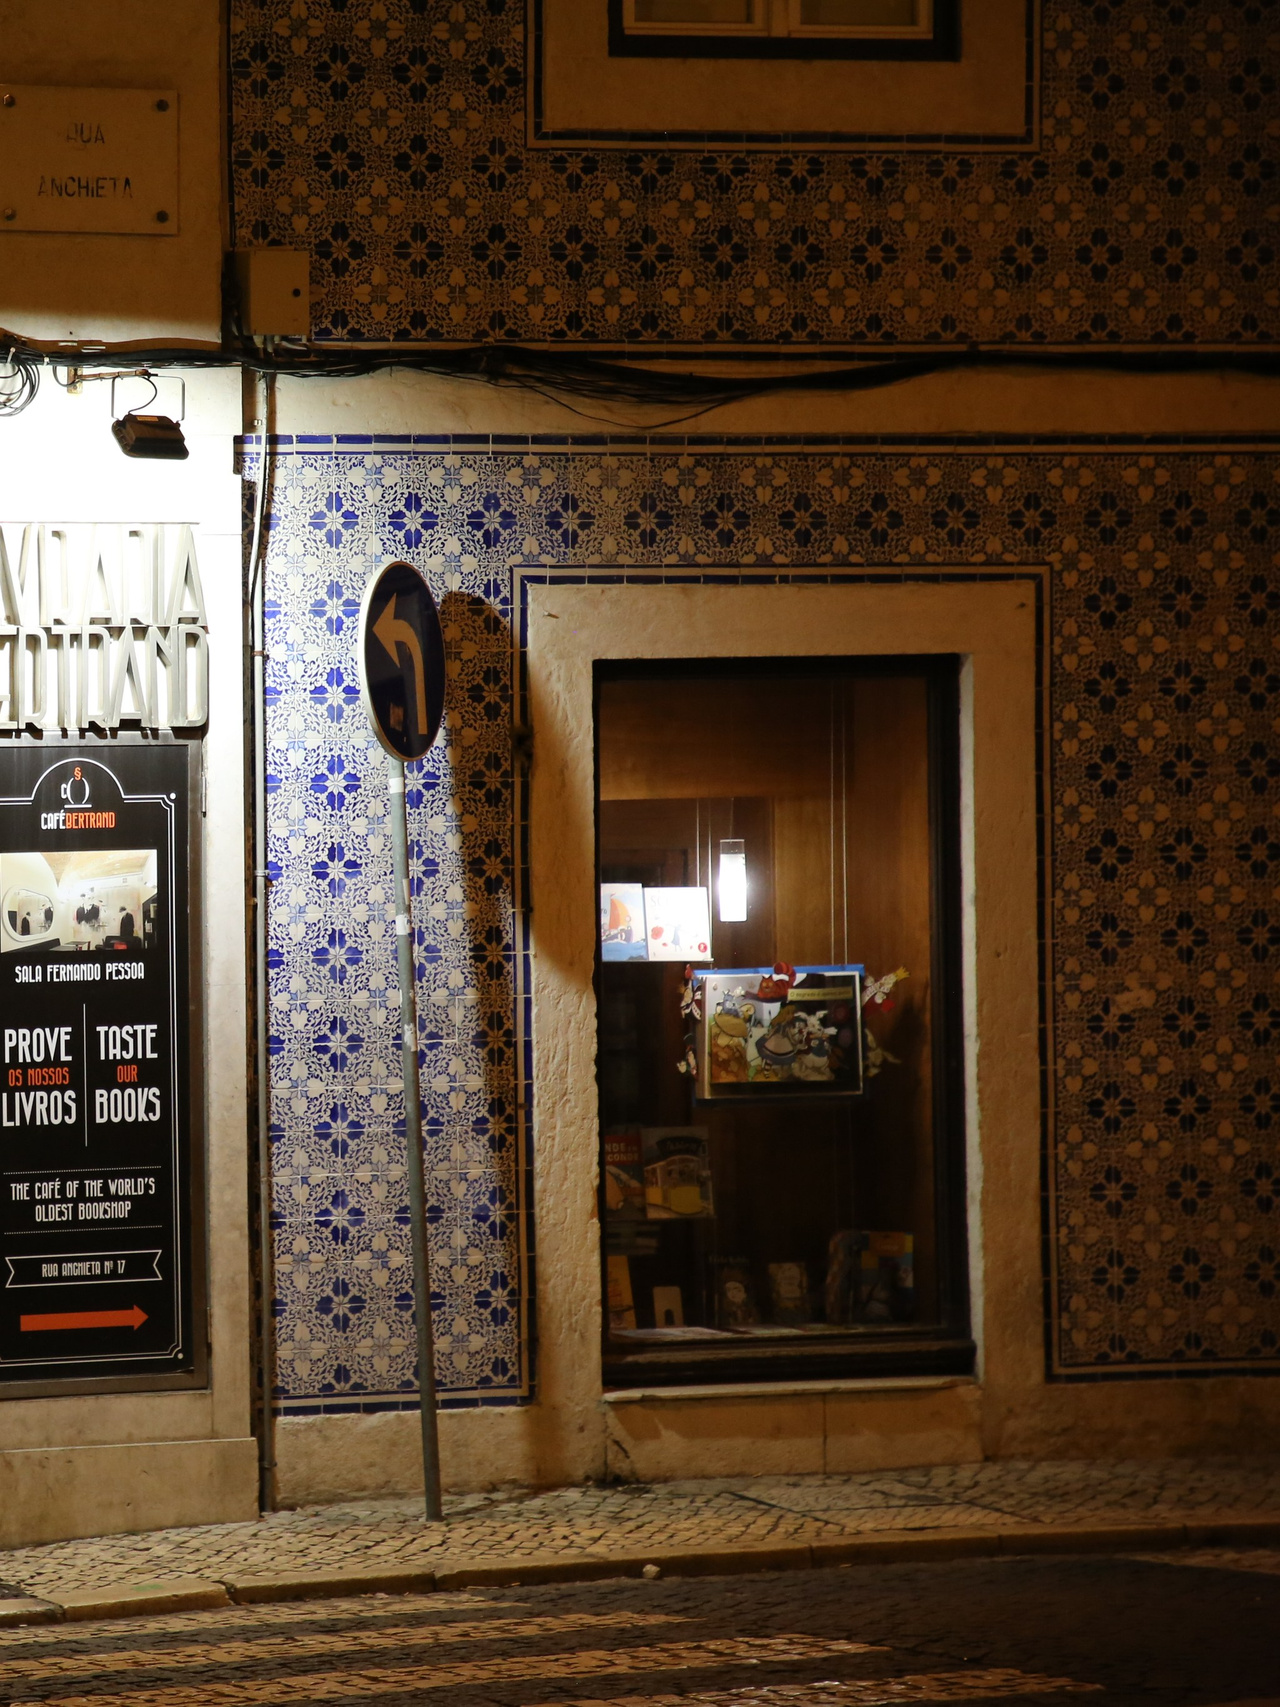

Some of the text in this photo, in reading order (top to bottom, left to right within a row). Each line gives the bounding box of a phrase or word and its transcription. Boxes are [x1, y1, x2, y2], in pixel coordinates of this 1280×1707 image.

[66, 122, 105, 144] RUA
[37, 175, 133, 199] ANCHIETA
[15, 962, 144, 984] SALA FERNANDO PESSOA
[4, 1026, 72, 1064] PROVE
[96, 1024, 158, 1060] TASTE
[8, 1067, 70, 1087] OS NOSSOS
[117, 1065, 138, 1083] OUR
[2, 1089, 77, 1128] LIVROS
[95, 1087, 161, 1124] BOOKS
[10, 1183, 30, 1201] THE
[35, 1178, 60, 1200] CAFÉ
[66, 1181, 79, 1198] OF
[84, 1180, 104, 1198] THE
[35, 1201, 132, 1222] OLDEST BOOKSHOP
[41, 1263, 59, 1278] RUA
[117, 1259, 126, 1274] 17
